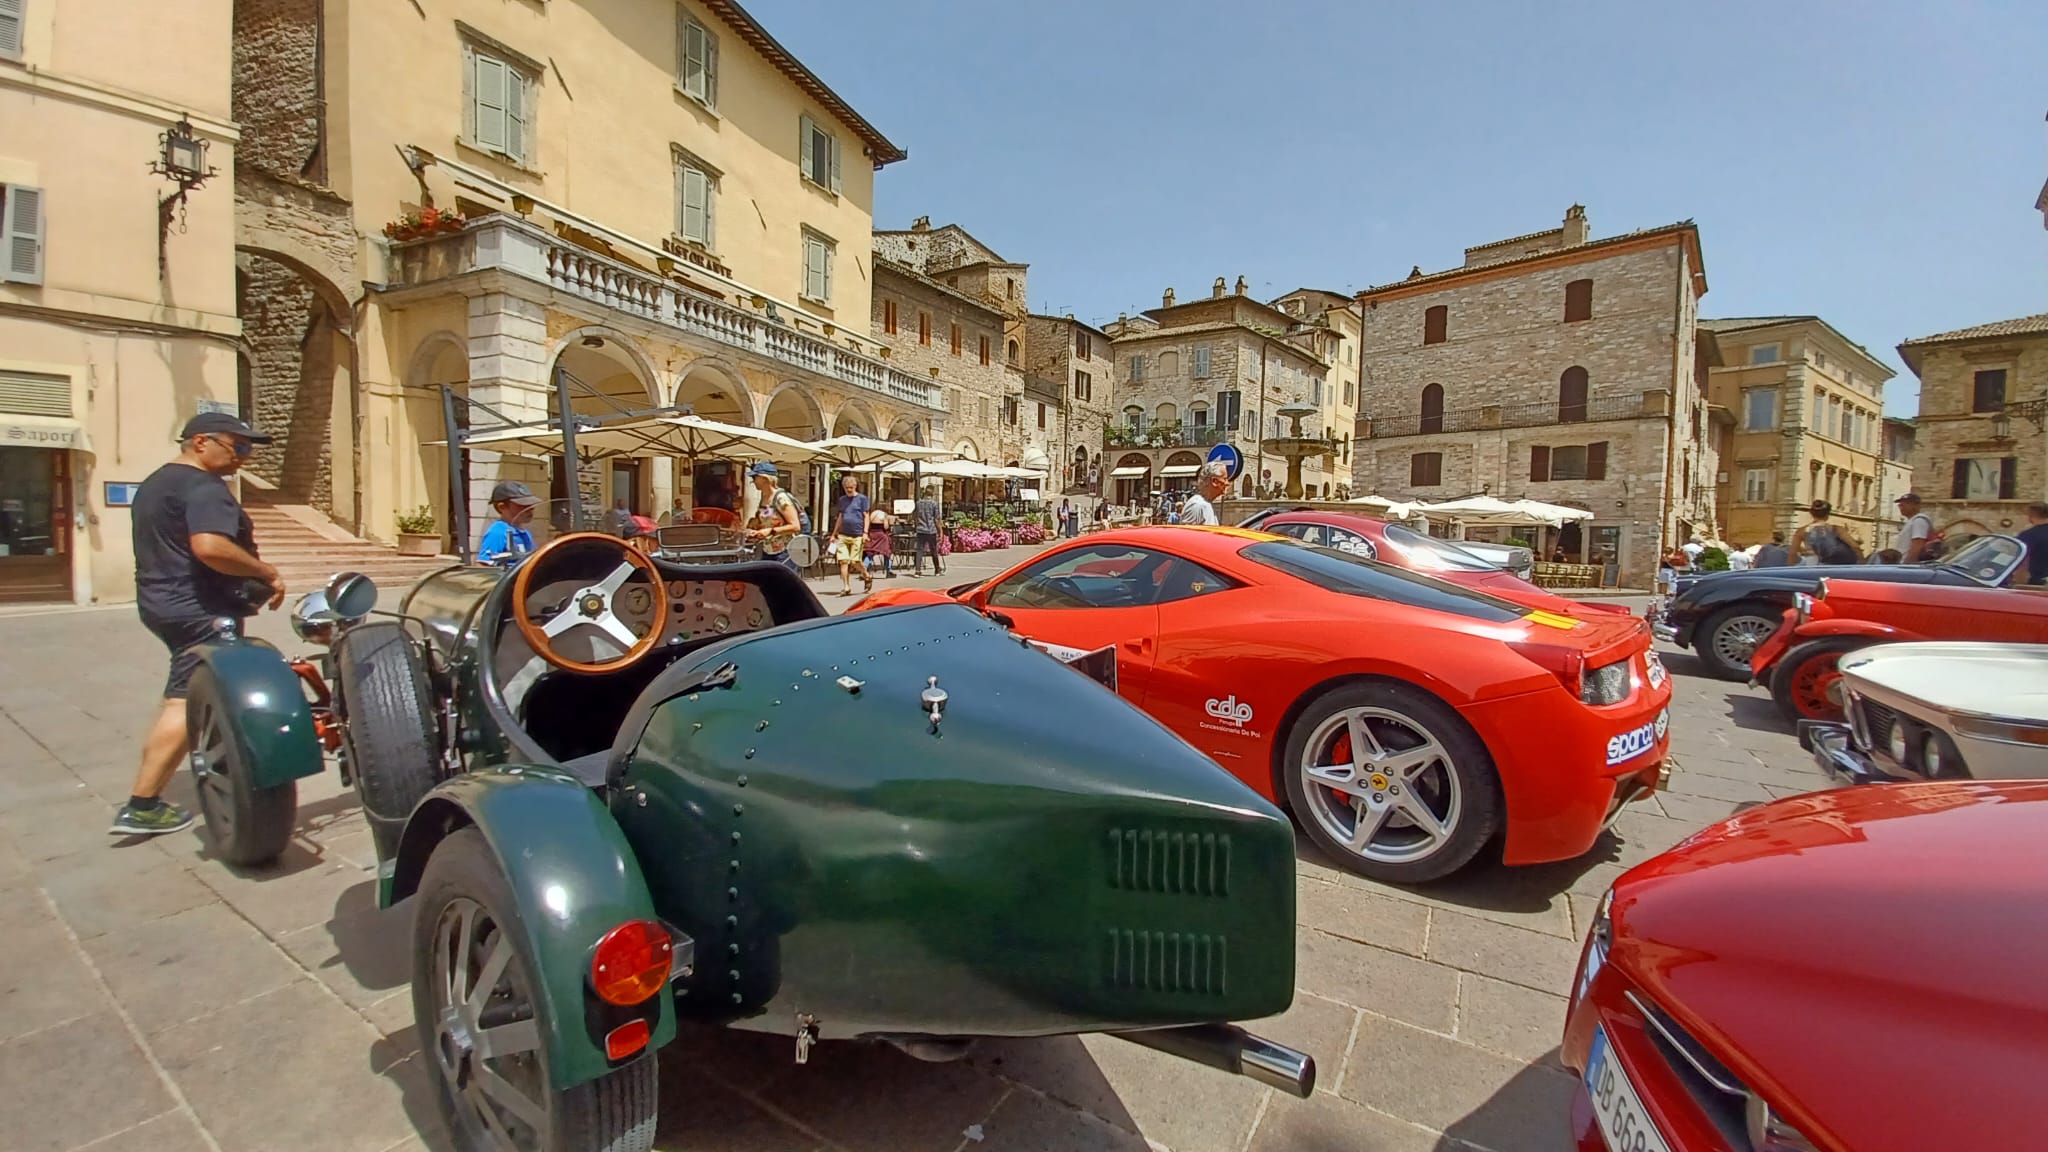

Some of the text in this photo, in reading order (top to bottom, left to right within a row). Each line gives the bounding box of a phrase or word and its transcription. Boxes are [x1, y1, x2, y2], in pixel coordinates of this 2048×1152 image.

[662, 238, 734, 280] RISTORANTE
[1205, 694, 1254, 728] cdp
[1607, 722, 1654, 763] sparco
[1612, 1095, 1656, 1152] 668
